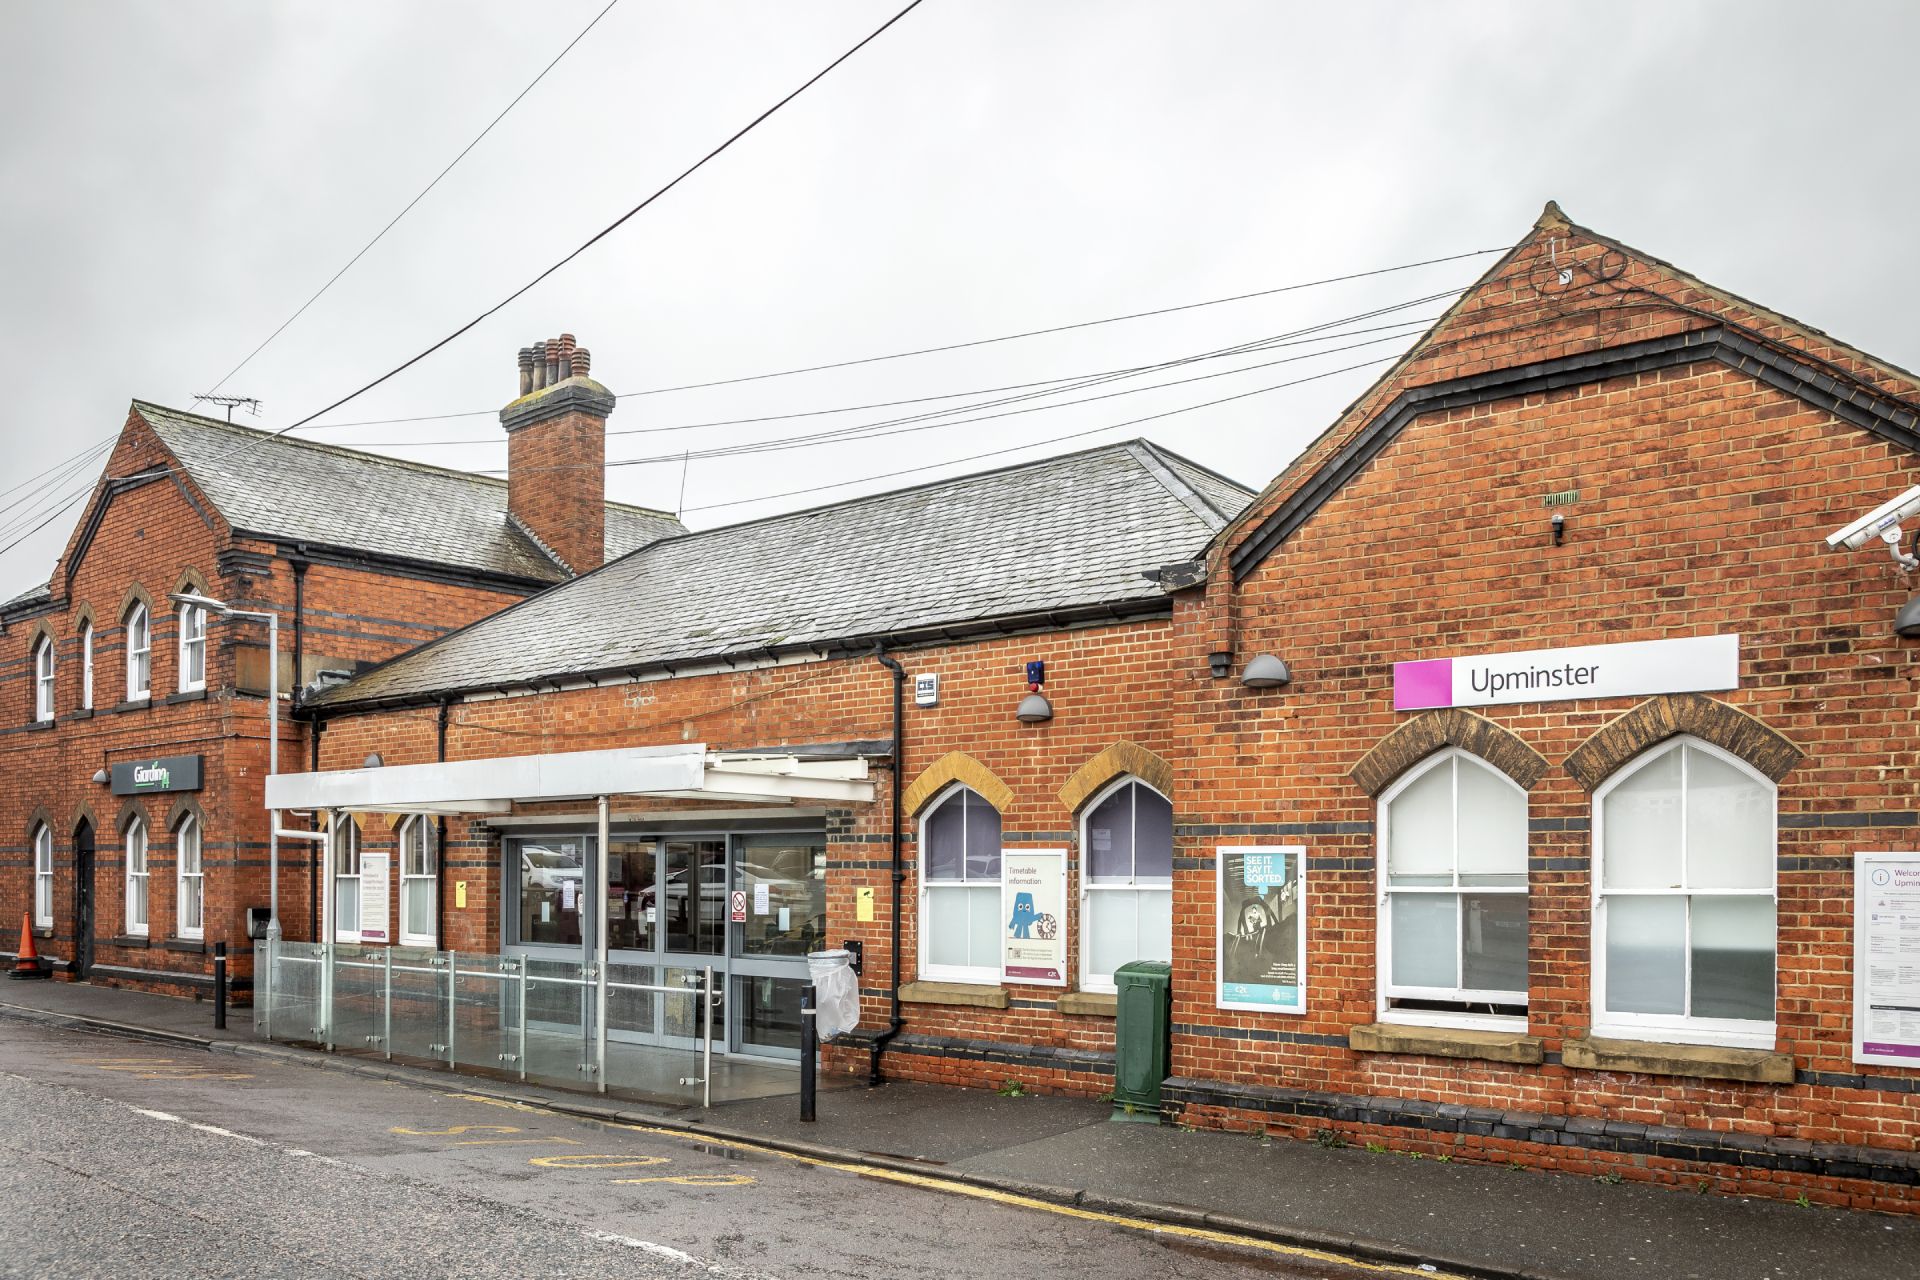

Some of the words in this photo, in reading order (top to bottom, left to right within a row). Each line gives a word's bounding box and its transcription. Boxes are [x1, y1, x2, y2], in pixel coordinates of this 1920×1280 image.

[1471, 664, 1599, 697] Upminster
[1246, 855, 1262, 865] SEE
[1263, 855, 1273, 865] IT.
[1009, 867, 1037, 875] Timetable
[1246, 865, 1262, 875] SAY
[1263, 865, 1274, 875] IT.
[1008, 877, 1042, 886] information
